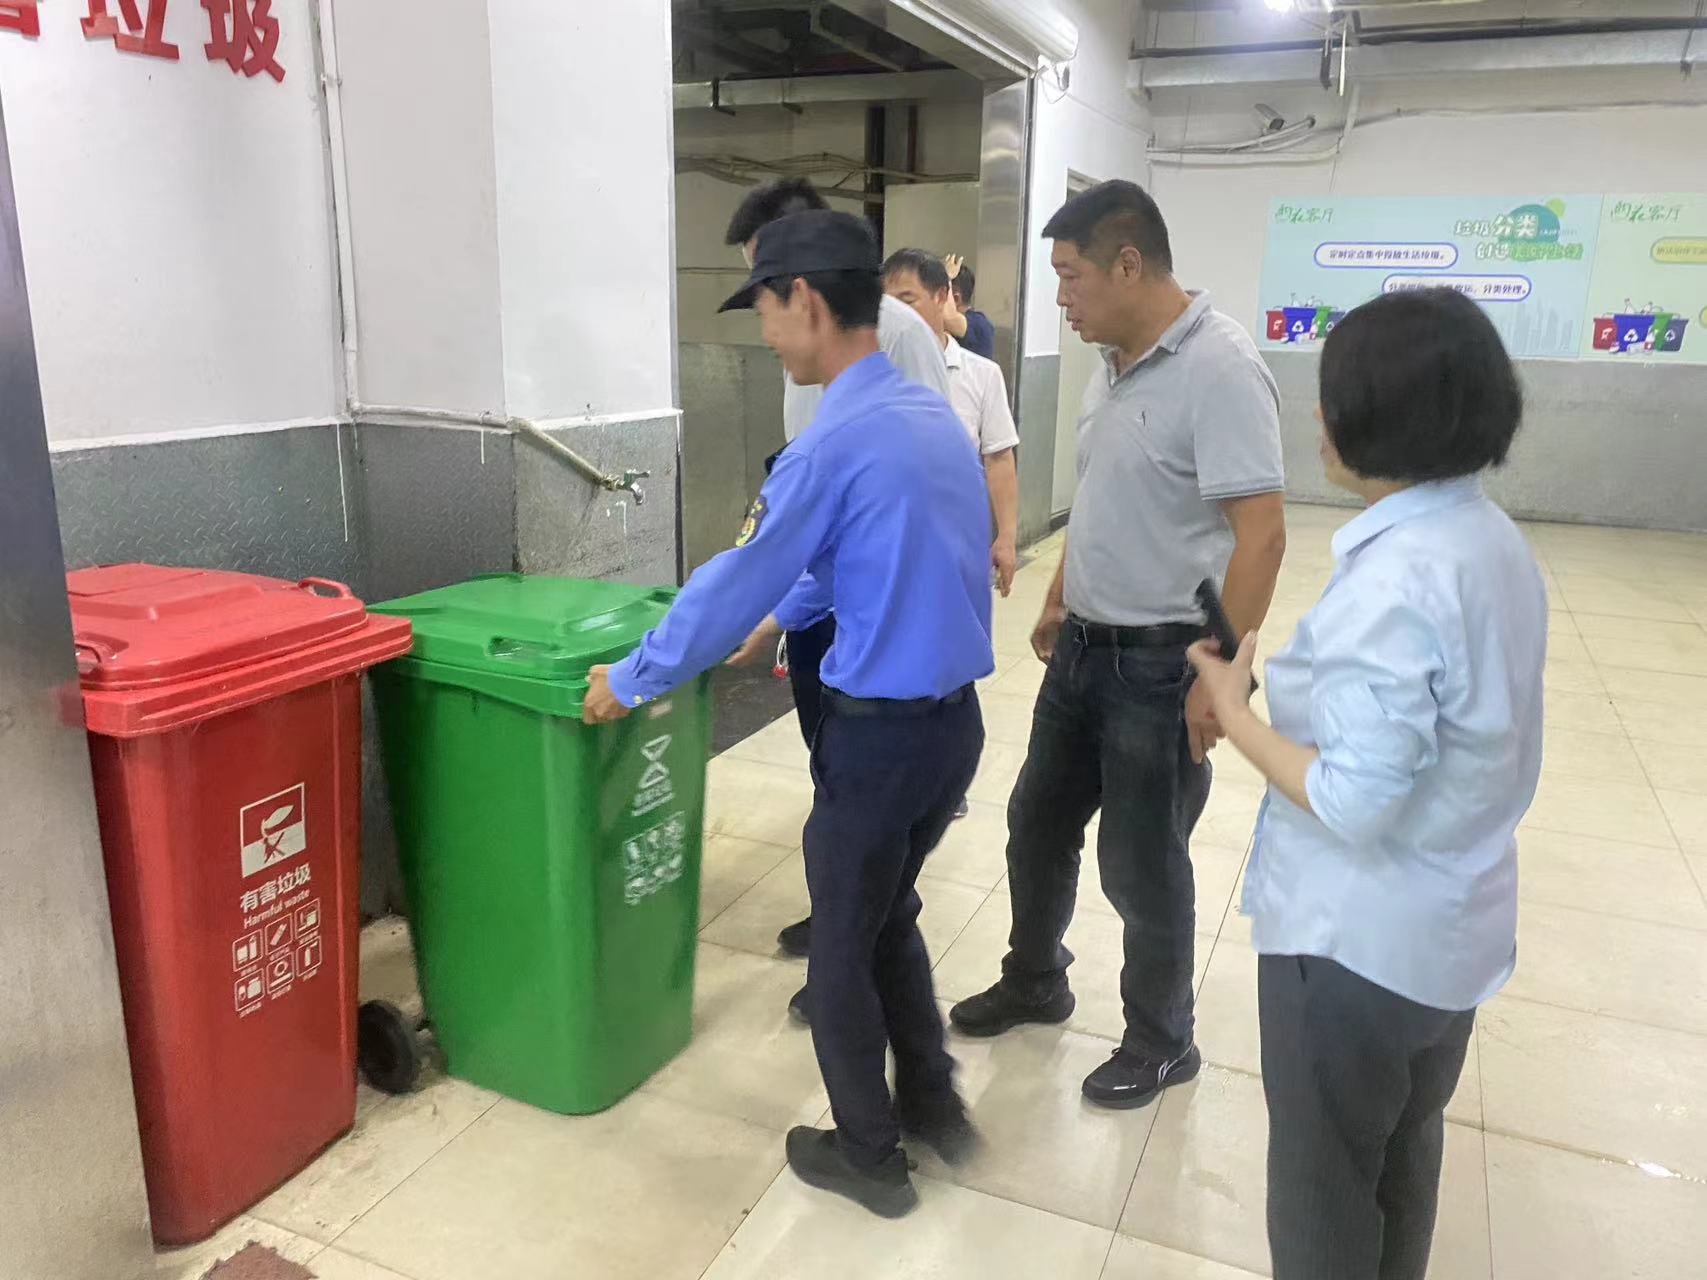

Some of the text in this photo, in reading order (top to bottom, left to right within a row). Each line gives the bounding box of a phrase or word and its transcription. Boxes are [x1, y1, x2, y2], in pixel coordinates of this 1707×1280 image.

[1454, 213, 1536, 238] 垃圾分类
[240, 862, 311, 913] 有害垃圾
[244, 889, 310, 929] Harmful waste
